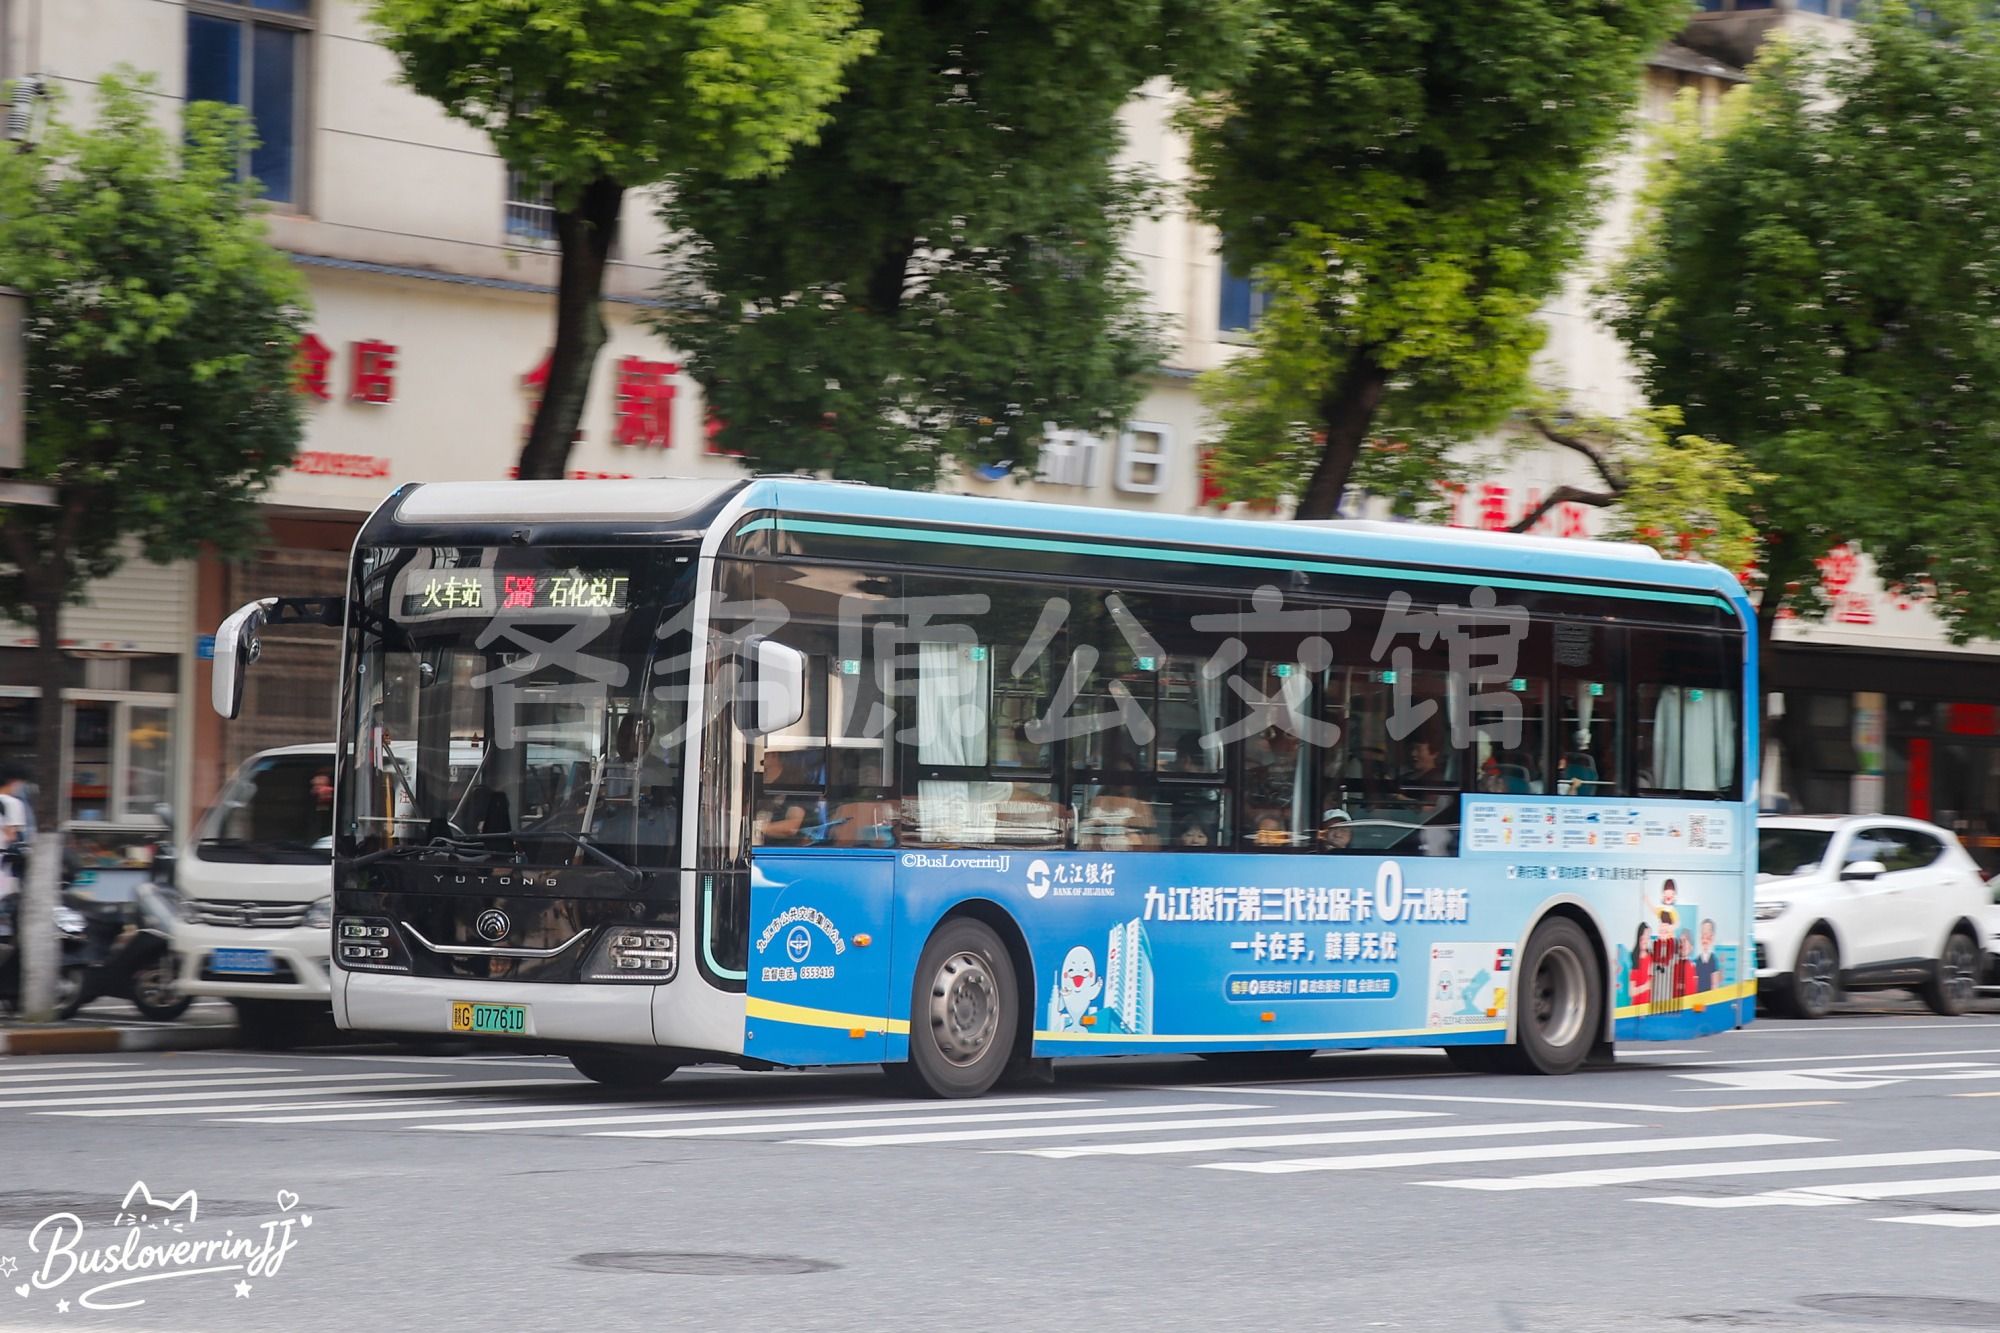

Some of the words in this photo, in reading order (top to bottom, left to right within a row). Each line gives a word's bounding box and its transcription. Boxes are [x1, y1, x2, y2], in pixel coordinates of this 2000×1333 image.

[421, 577, 482, 608] 火车站
[504, 576, 536, 608] 5路
[550, 577, 629, 607] 石化总厂
[434, 874, 557, 887] YUTONG
[1053, 863, 1116, 885] 九江银行
[1053, 888, 1072, 896] BANK
[1073, 888, 1082, 896] OF
[1143, 860, 1468, 922] 九江银行第三代社保卡0元焕新
[757, 906, 846, 955] 九江市公共交通集团公司
